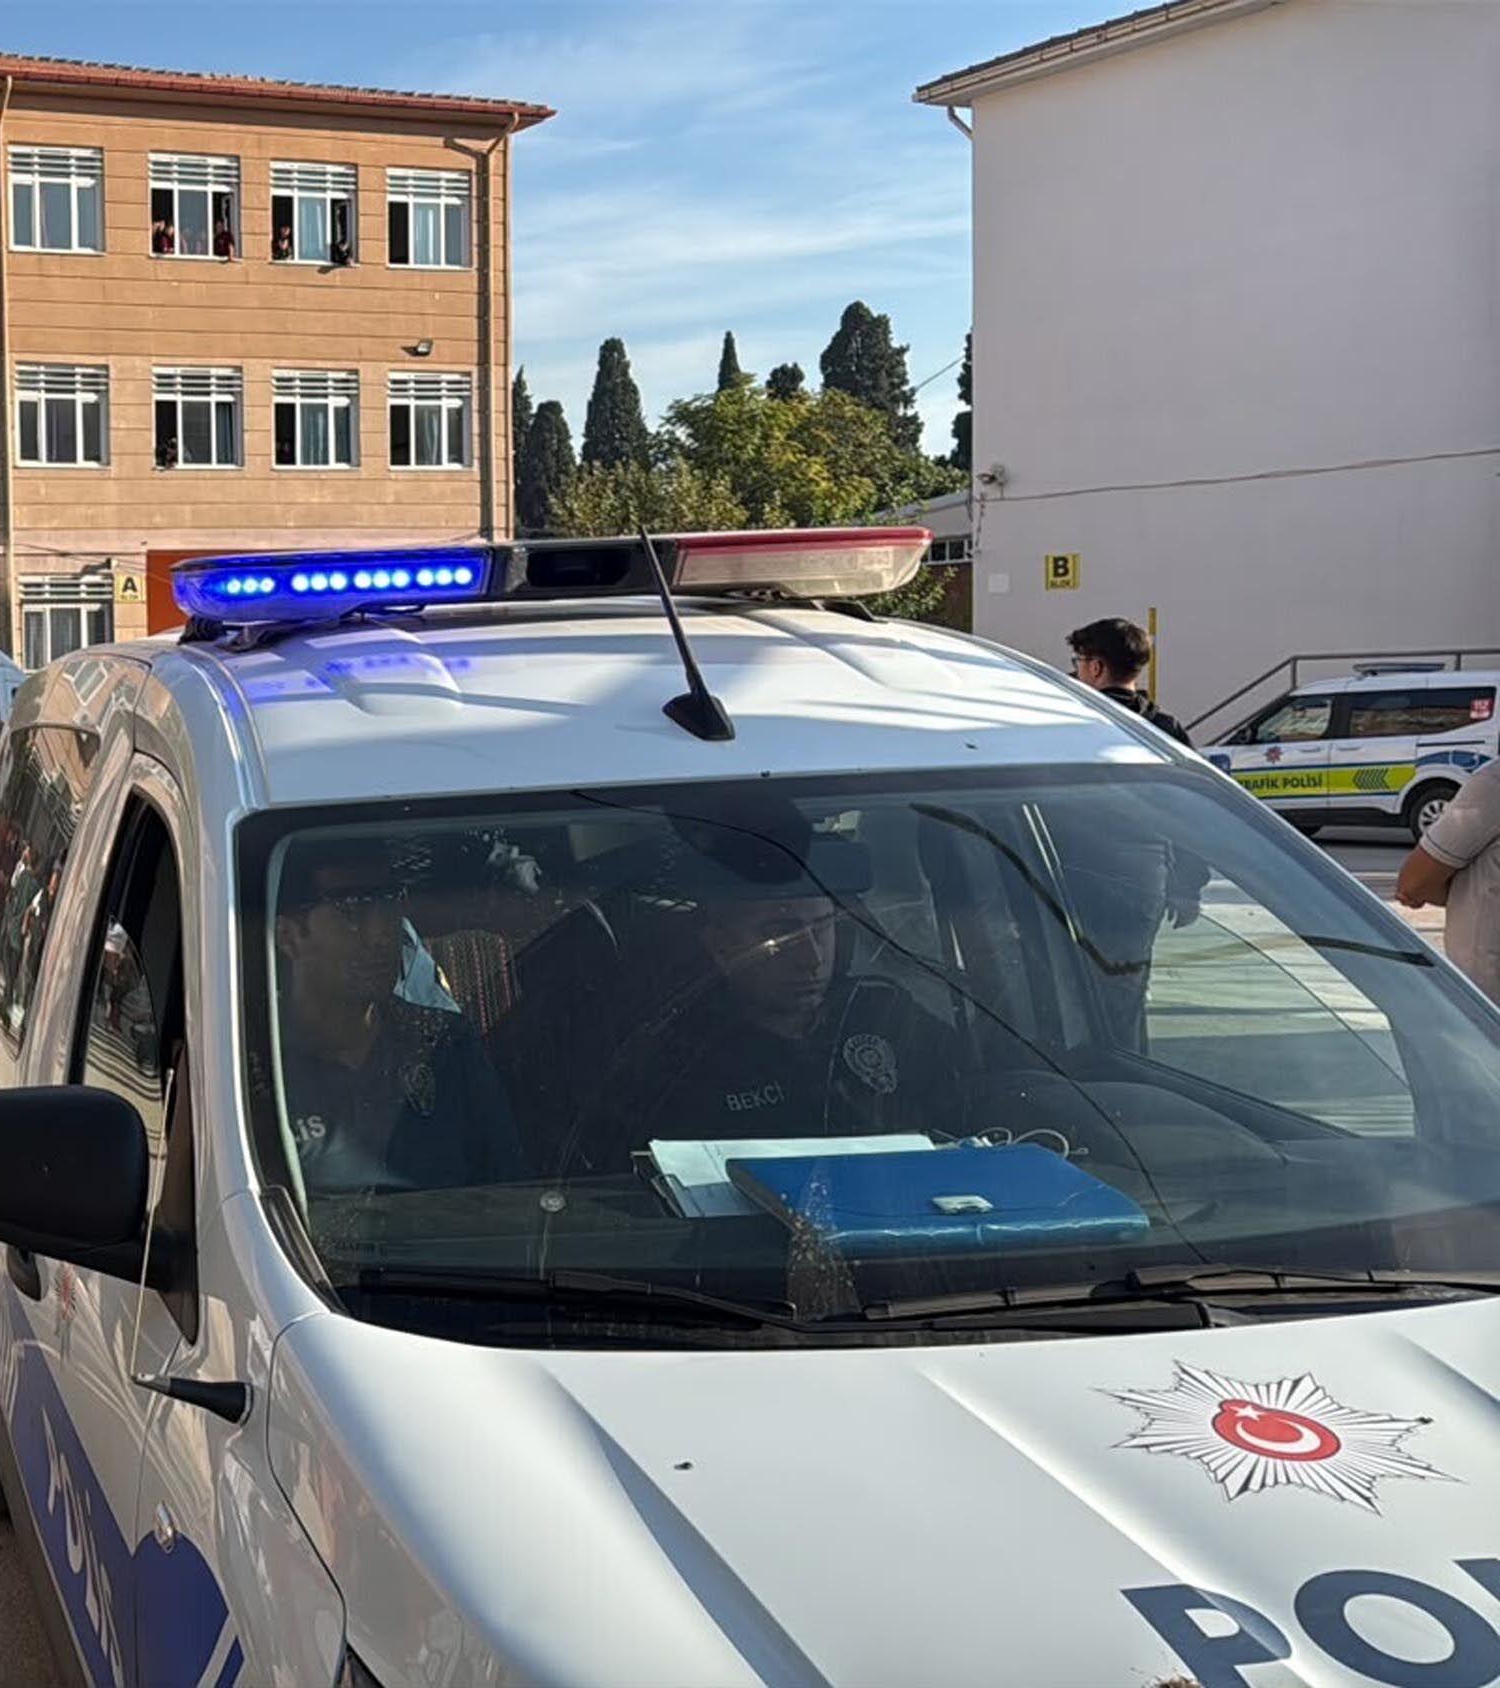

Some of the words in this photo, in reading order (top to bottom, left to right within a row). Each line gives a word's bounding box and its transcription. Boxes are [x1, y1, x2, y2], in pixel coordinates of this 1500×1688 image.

[1053, 557, 1069, 578] B
[121, 577, 137, 592] A
[1283, 774, 1323, 789] POLİSİ
[1120, 1558, 1500, 1688] PO
